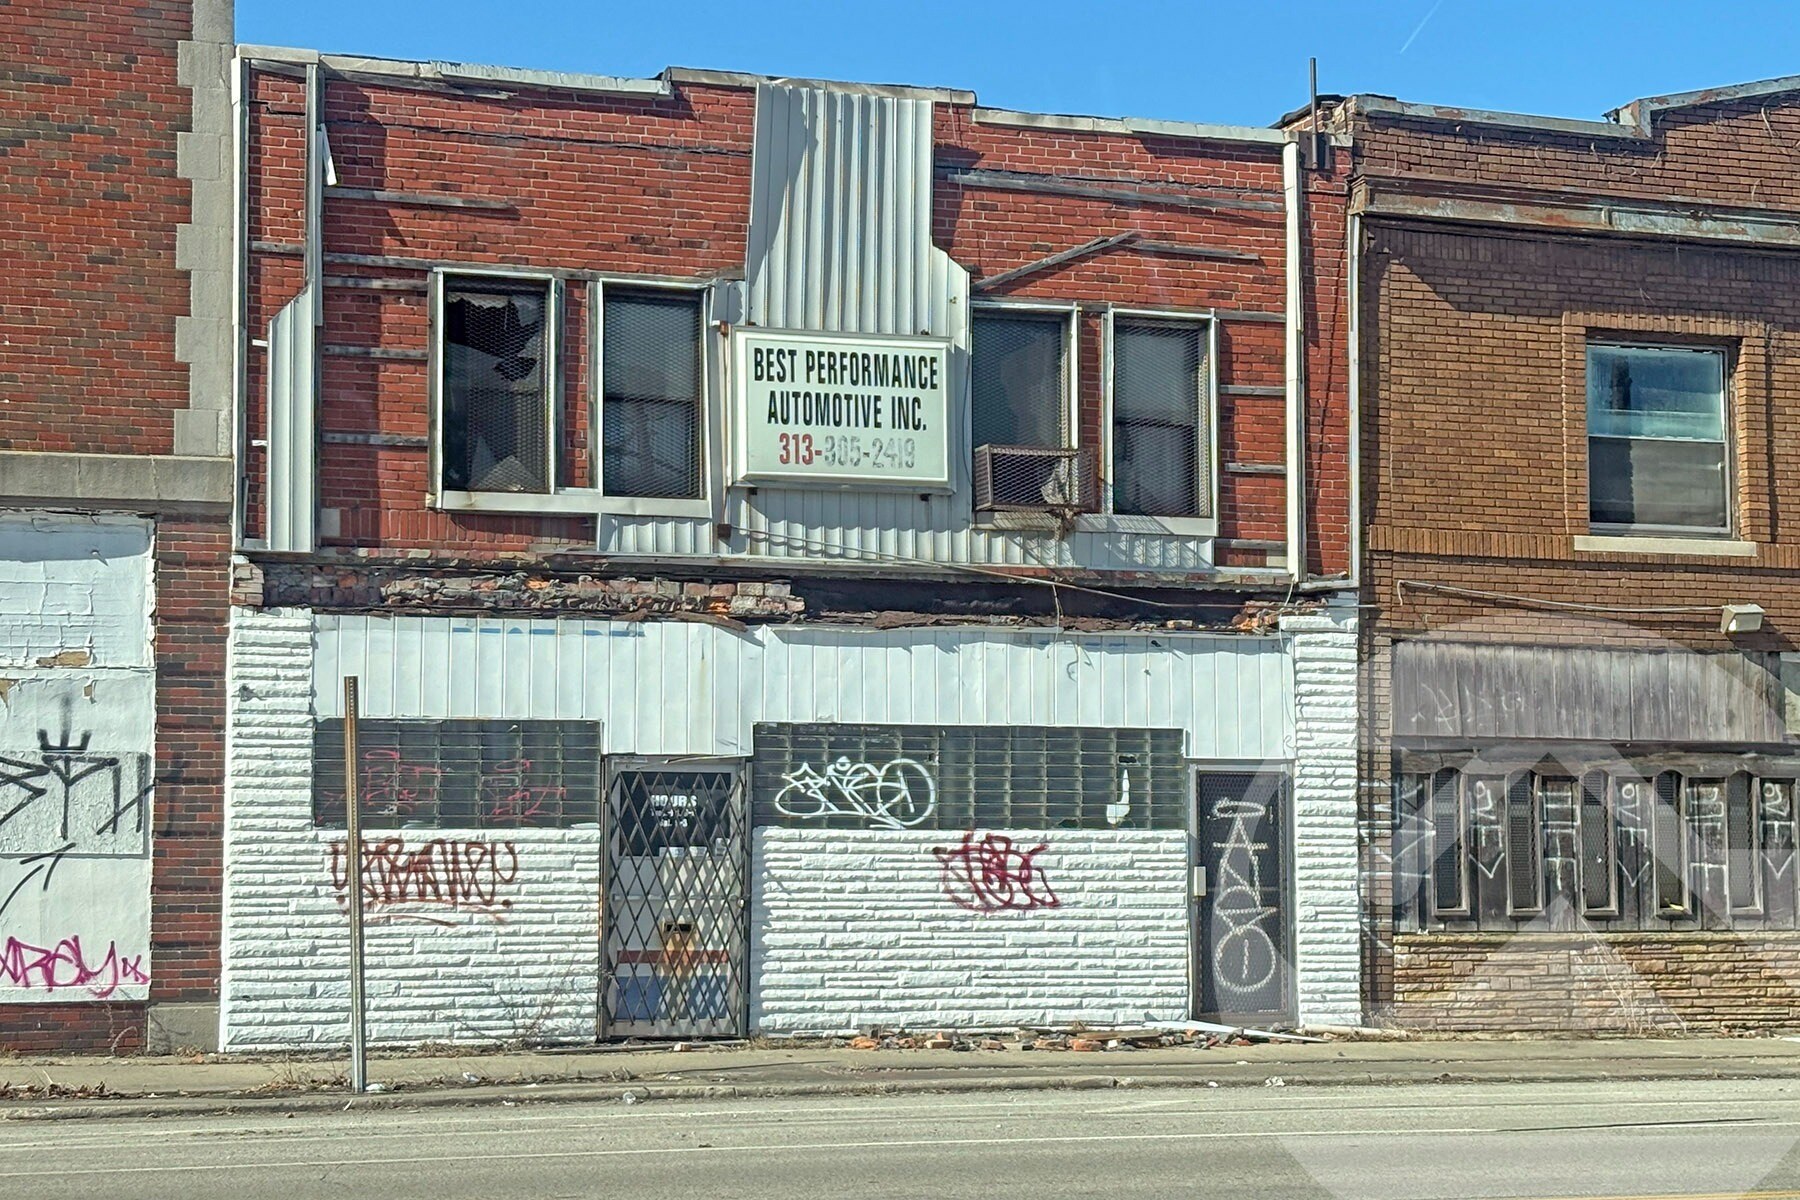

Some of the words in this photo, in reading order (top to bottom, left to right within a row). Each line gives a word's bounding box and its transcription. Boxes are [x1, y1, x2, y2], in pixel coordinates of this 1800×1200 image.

[754, 347, 797, 383] BEST
[806, 350, 938, 390] PERFORMANCE
[767, 390, 882, 429] AUTOMOTIVE
[891, 396, 927, 431] INC.
[650, 794, 698, 808] HOURS
